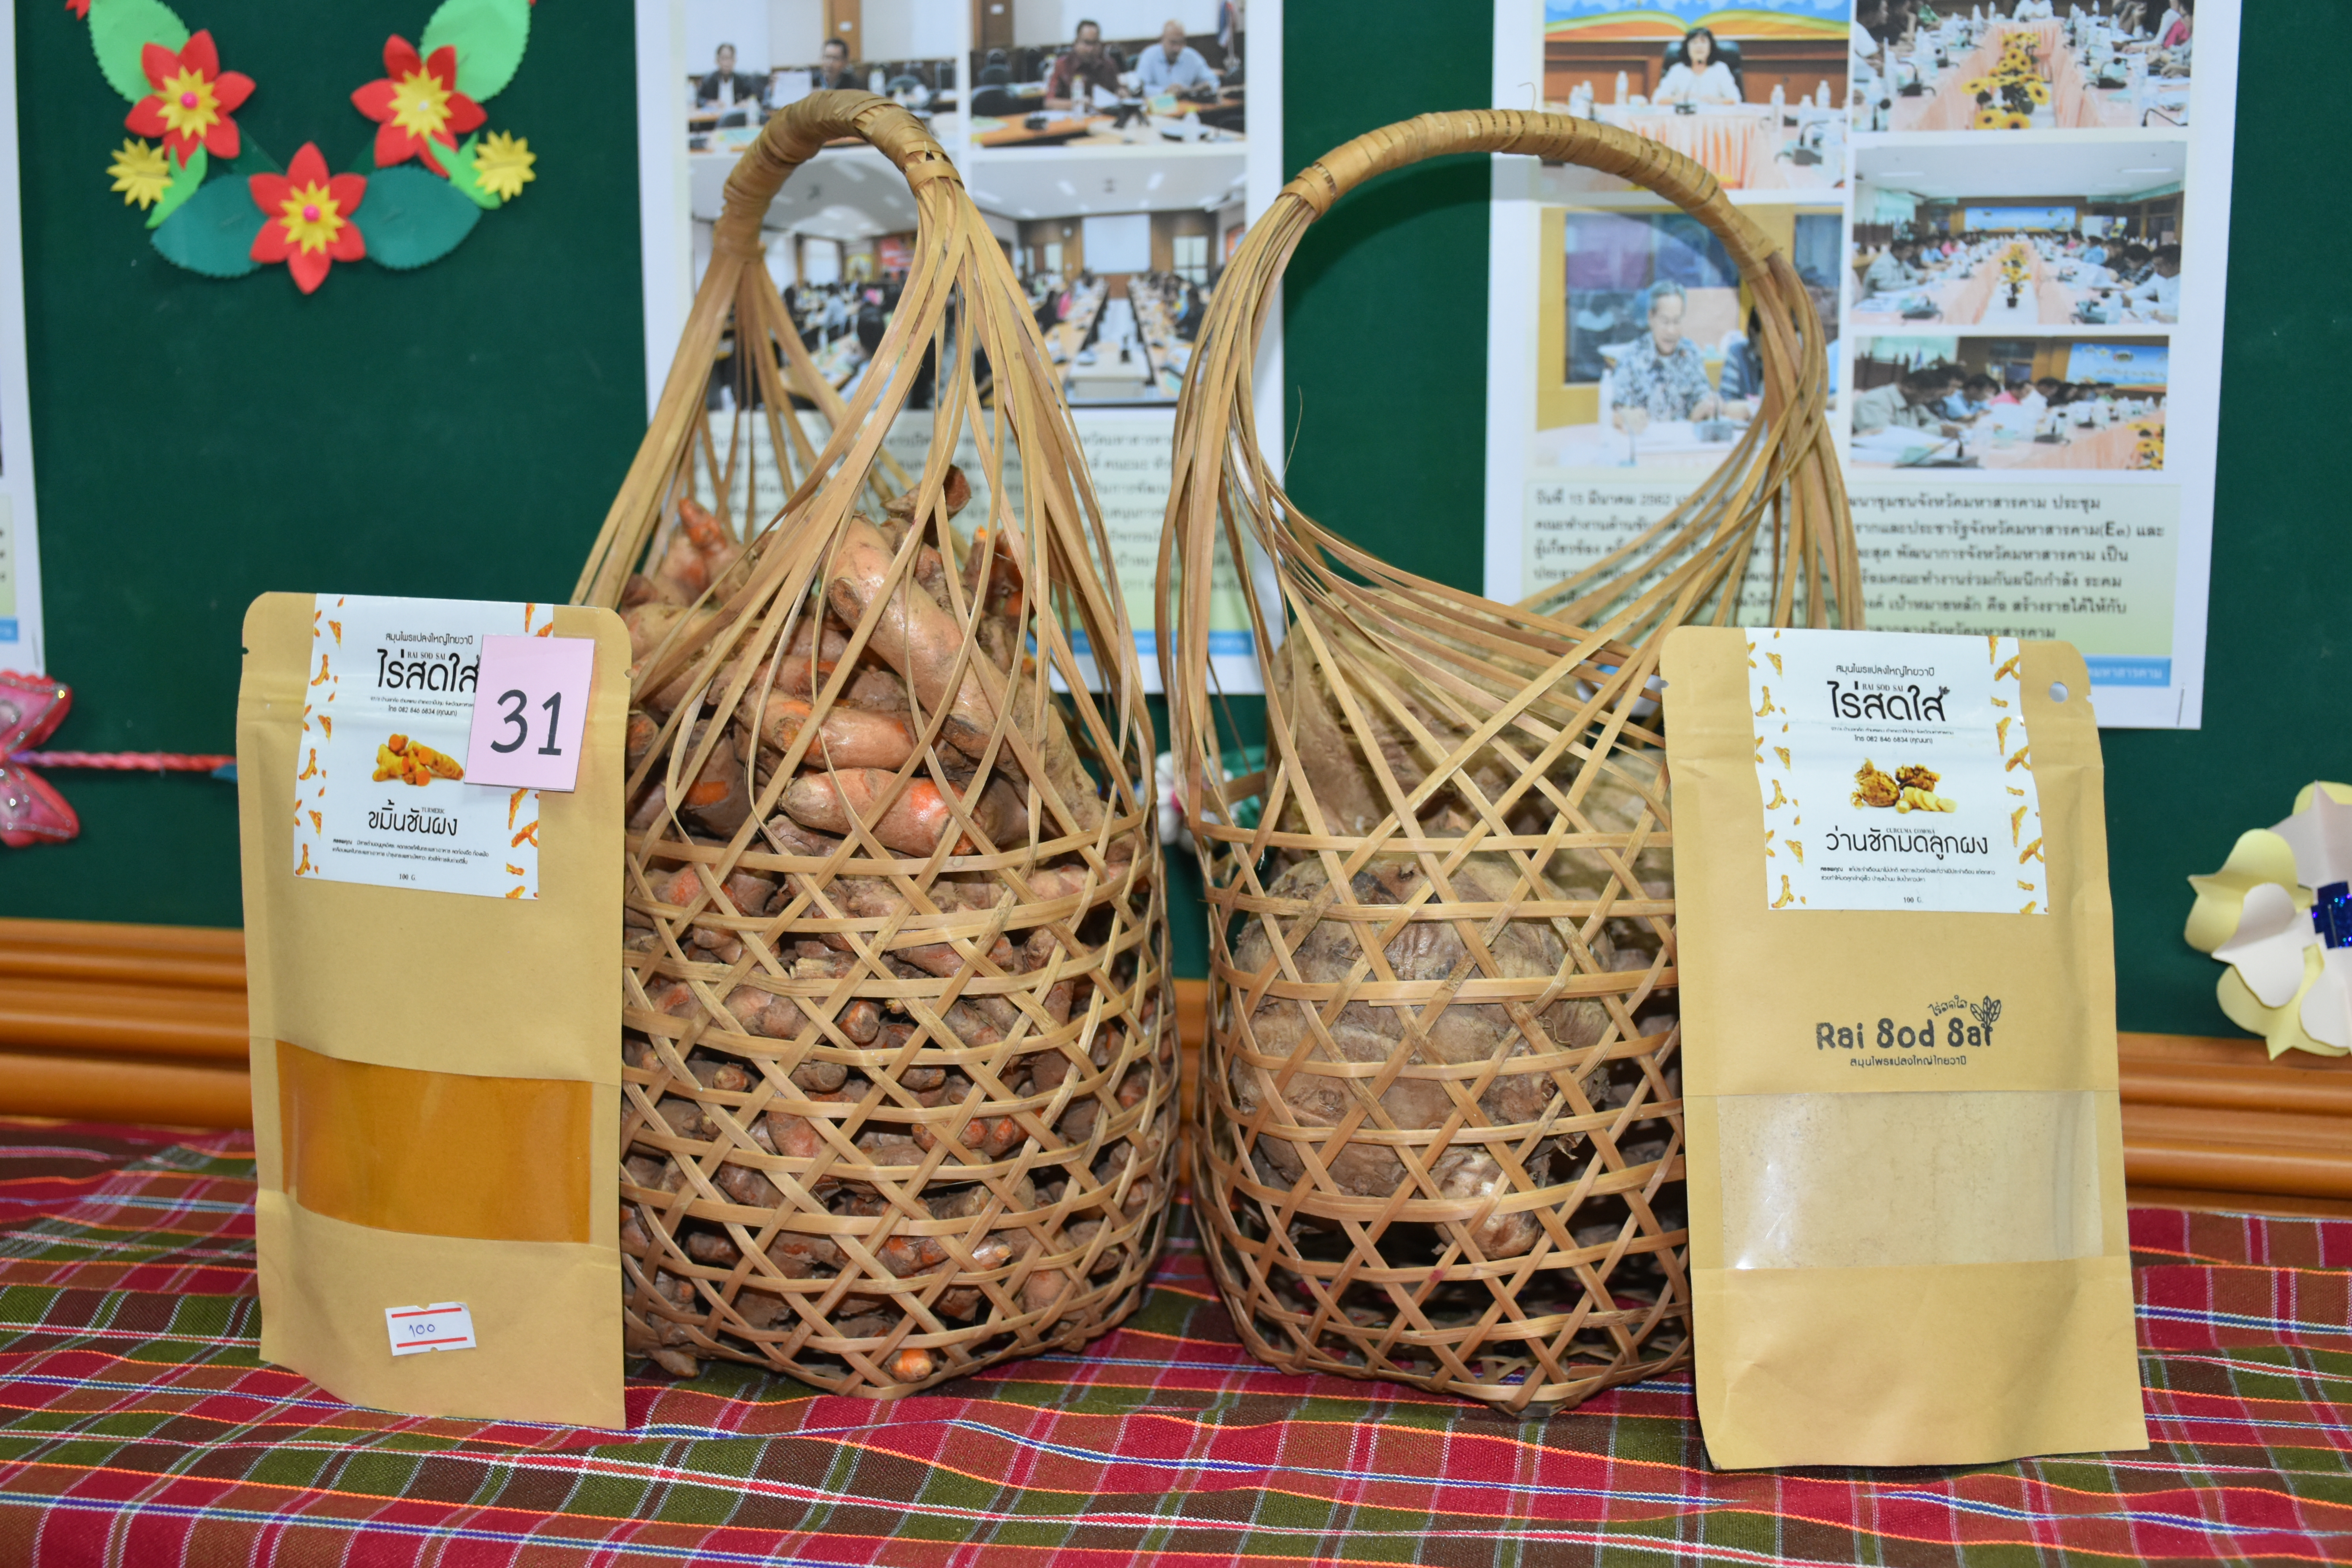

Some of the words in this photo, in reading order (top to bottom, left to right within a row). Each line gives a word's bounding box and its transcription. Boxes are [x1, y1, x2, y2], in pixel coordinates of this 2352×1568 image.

[1827, 680, 1946, 722] ไร่สดใส
[490, 689, 562, 756] 31
[368, 799, 457, 836] ขมิ้นชันผง
[1826, 825, 1988, 860] ว่านชักมดลูกผง
[1816, 1022, 1864, 1051] Rai
[408, 1323, 436, 1338] 100
